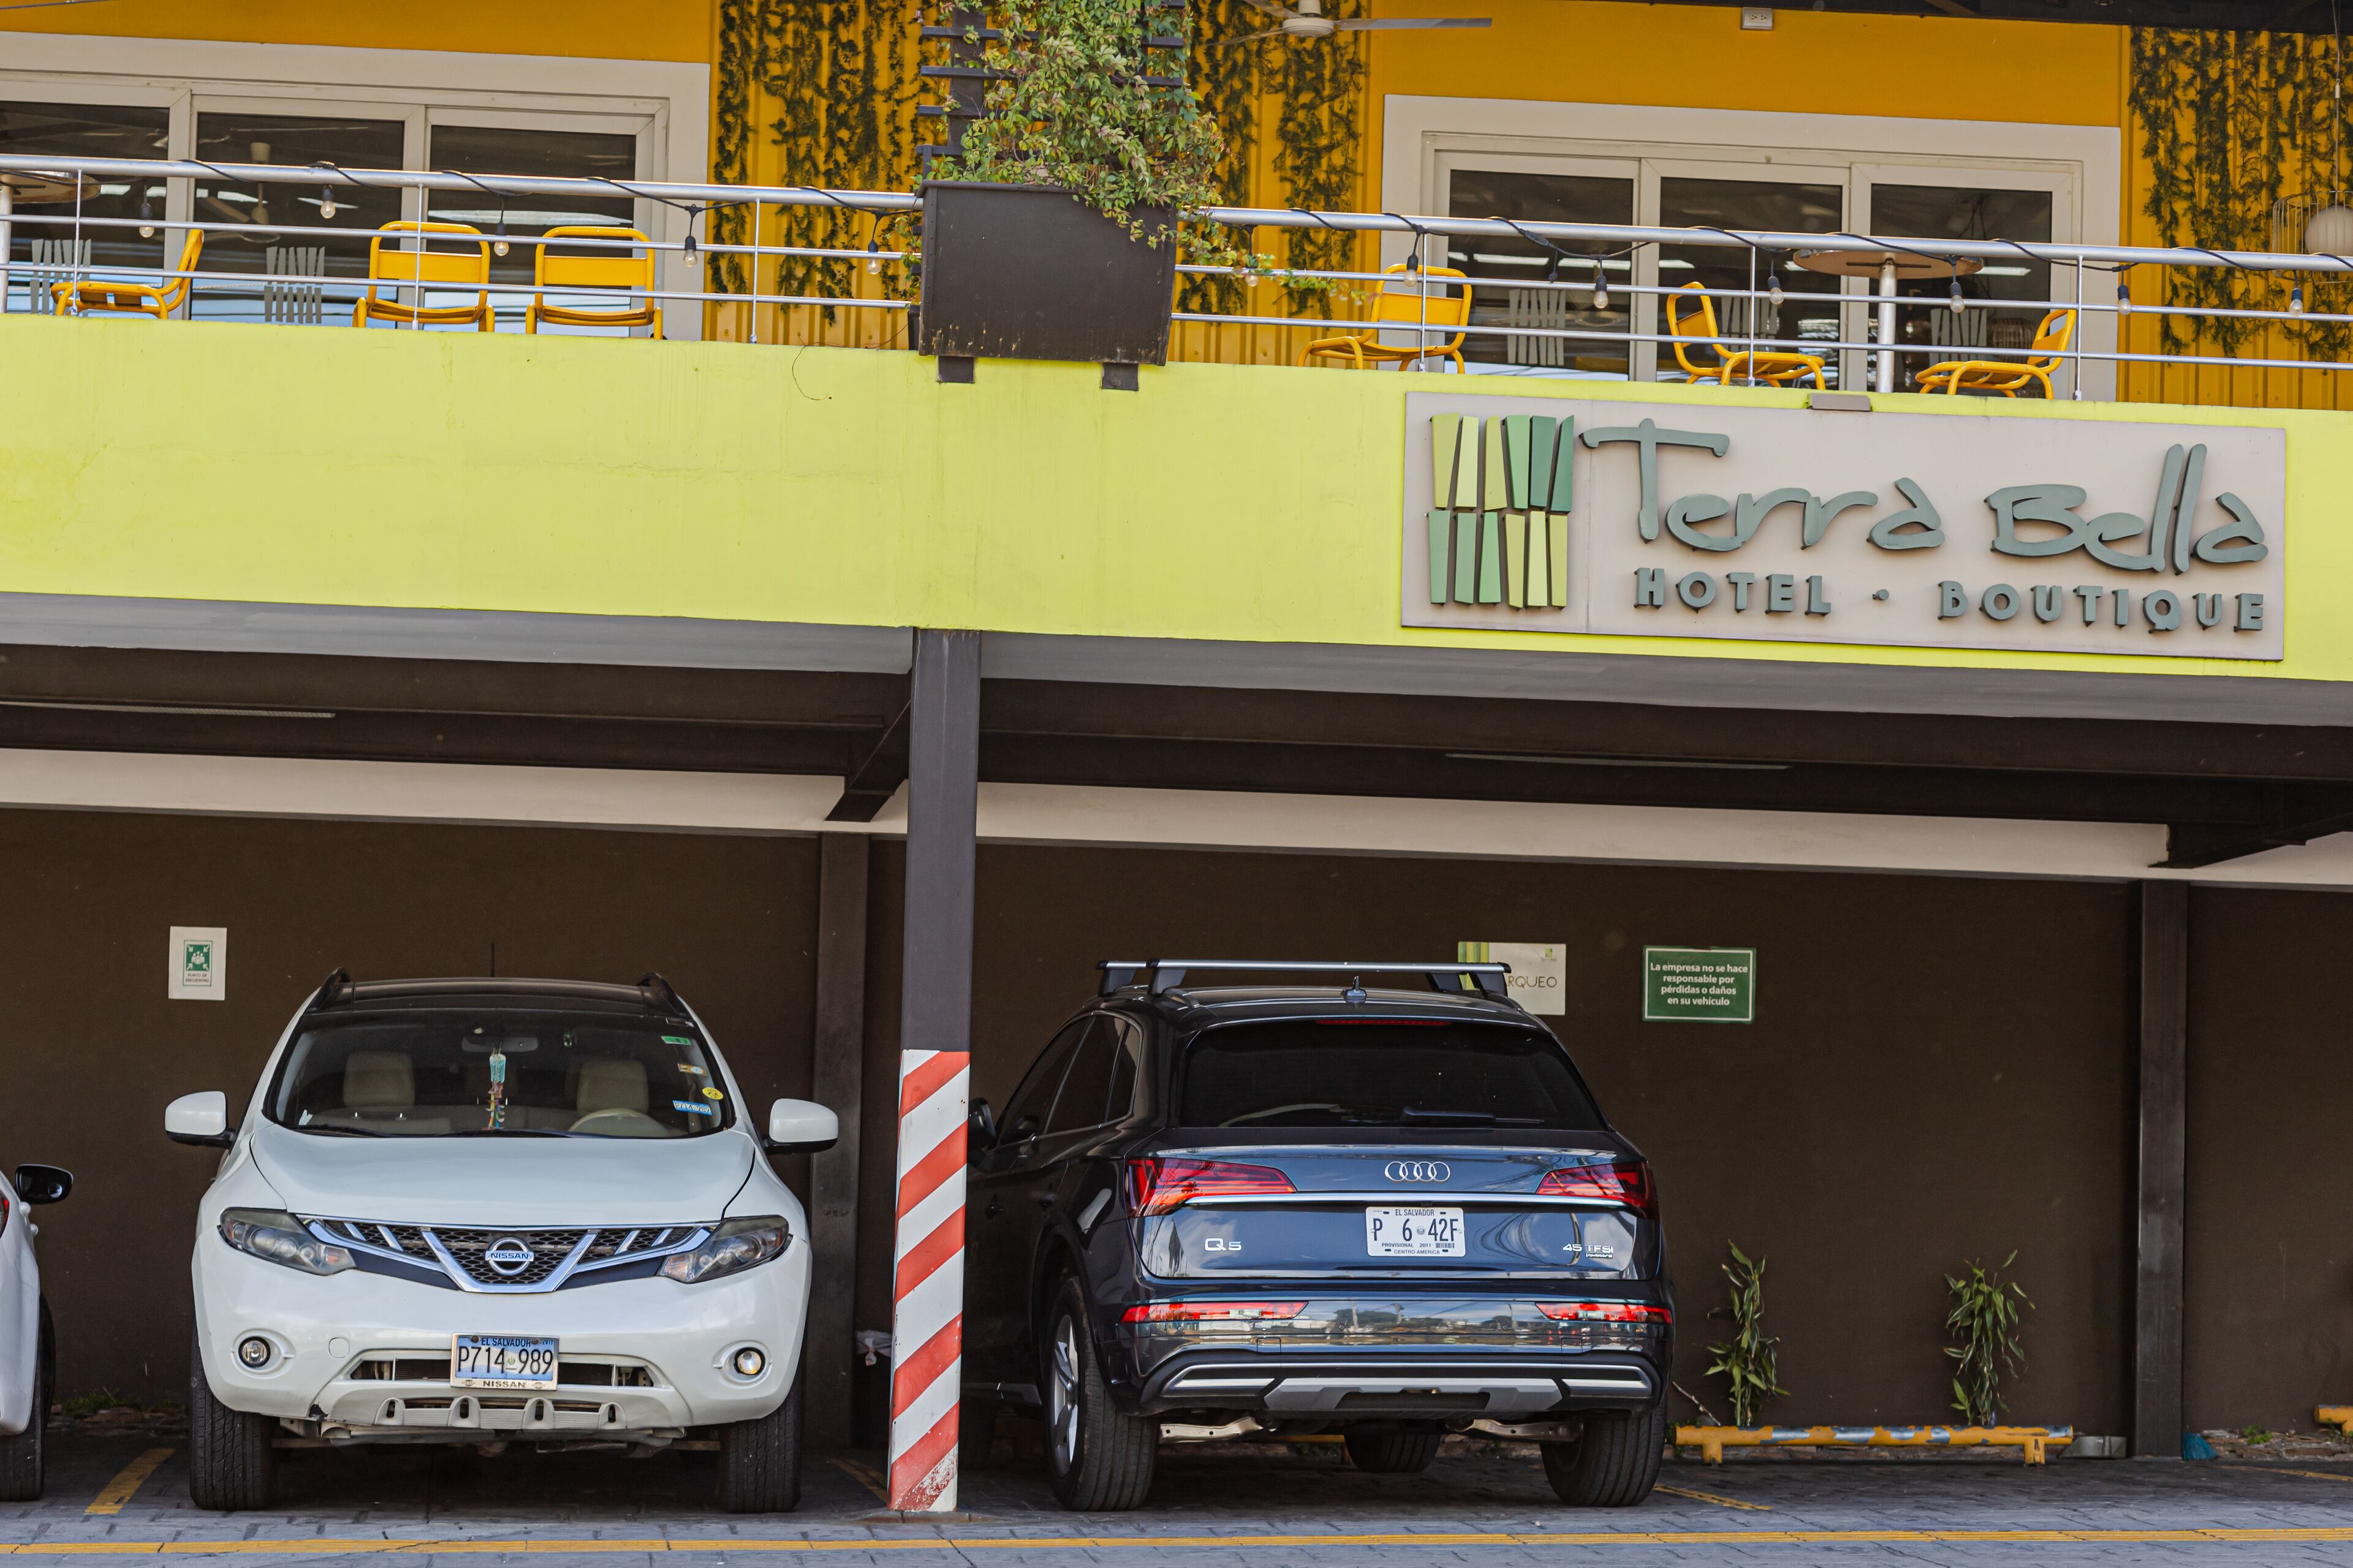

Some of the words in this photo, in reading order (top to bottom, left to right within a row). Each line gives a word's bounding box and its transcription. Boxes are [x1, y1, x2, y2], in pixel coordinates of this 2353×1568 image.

[1579, 418, 1945, 551] Terra
[1984, 443, 2268, 574] Bella
[1634, 567, 1832, 616] HOTEL
[1938, 580, 2264, 634] BOUTIQUE
[1651, 963, 1661, 971] La
[1662, 963, 1700, 973] empresa
[1727, 964, 1748, 973] hace
[1508, 975, 1558, 988] RQUEO
[1663, 974, 1717, 984] responsable
[1719, 977, 1735, 985] por
[1661, 985, 1700, 995] pérdidas
[1709, 986, 1737, 995] daños
[1692, 997, 1730, 1006] vehículo
[1373, 1218, 1383, 1241] P
[1402, 1218, 1412, 1241] 6
[1428, 1218, 1458, 1241] 42F
[1585, 1244, 1613, 1253] TFSI
[492, 1338, 531, 1347] SALVADOR
